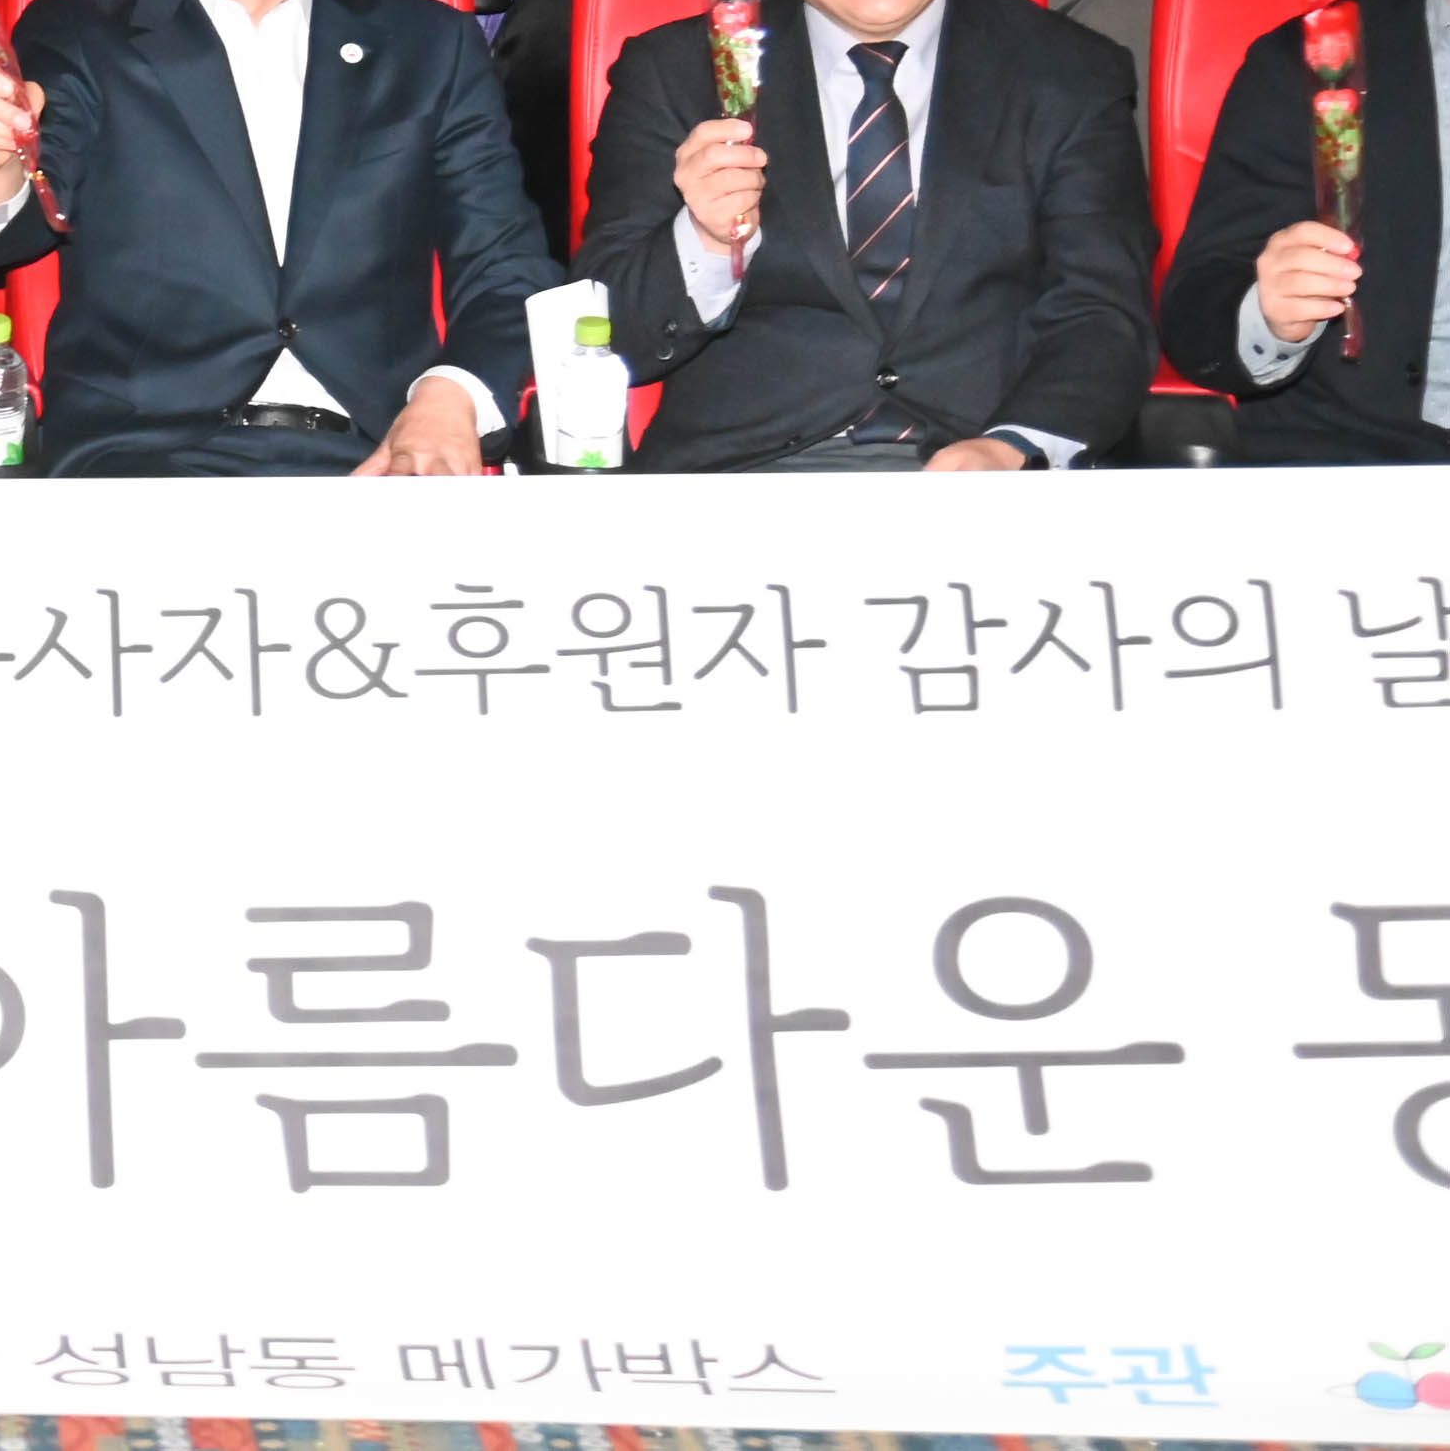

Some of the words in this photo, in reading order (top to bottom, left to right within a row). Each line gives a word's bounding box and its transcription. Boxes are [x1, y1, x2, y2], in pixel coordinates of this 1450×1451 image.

[864, 579, 1283, 714] 감사의
[1338, 576, 1450, 709] 날
[34, 1333, 356, 1389] 성남동
[398, 1338, 837, 1396] 메가박스
[1003, 1345, 1218, 1407] 주관
